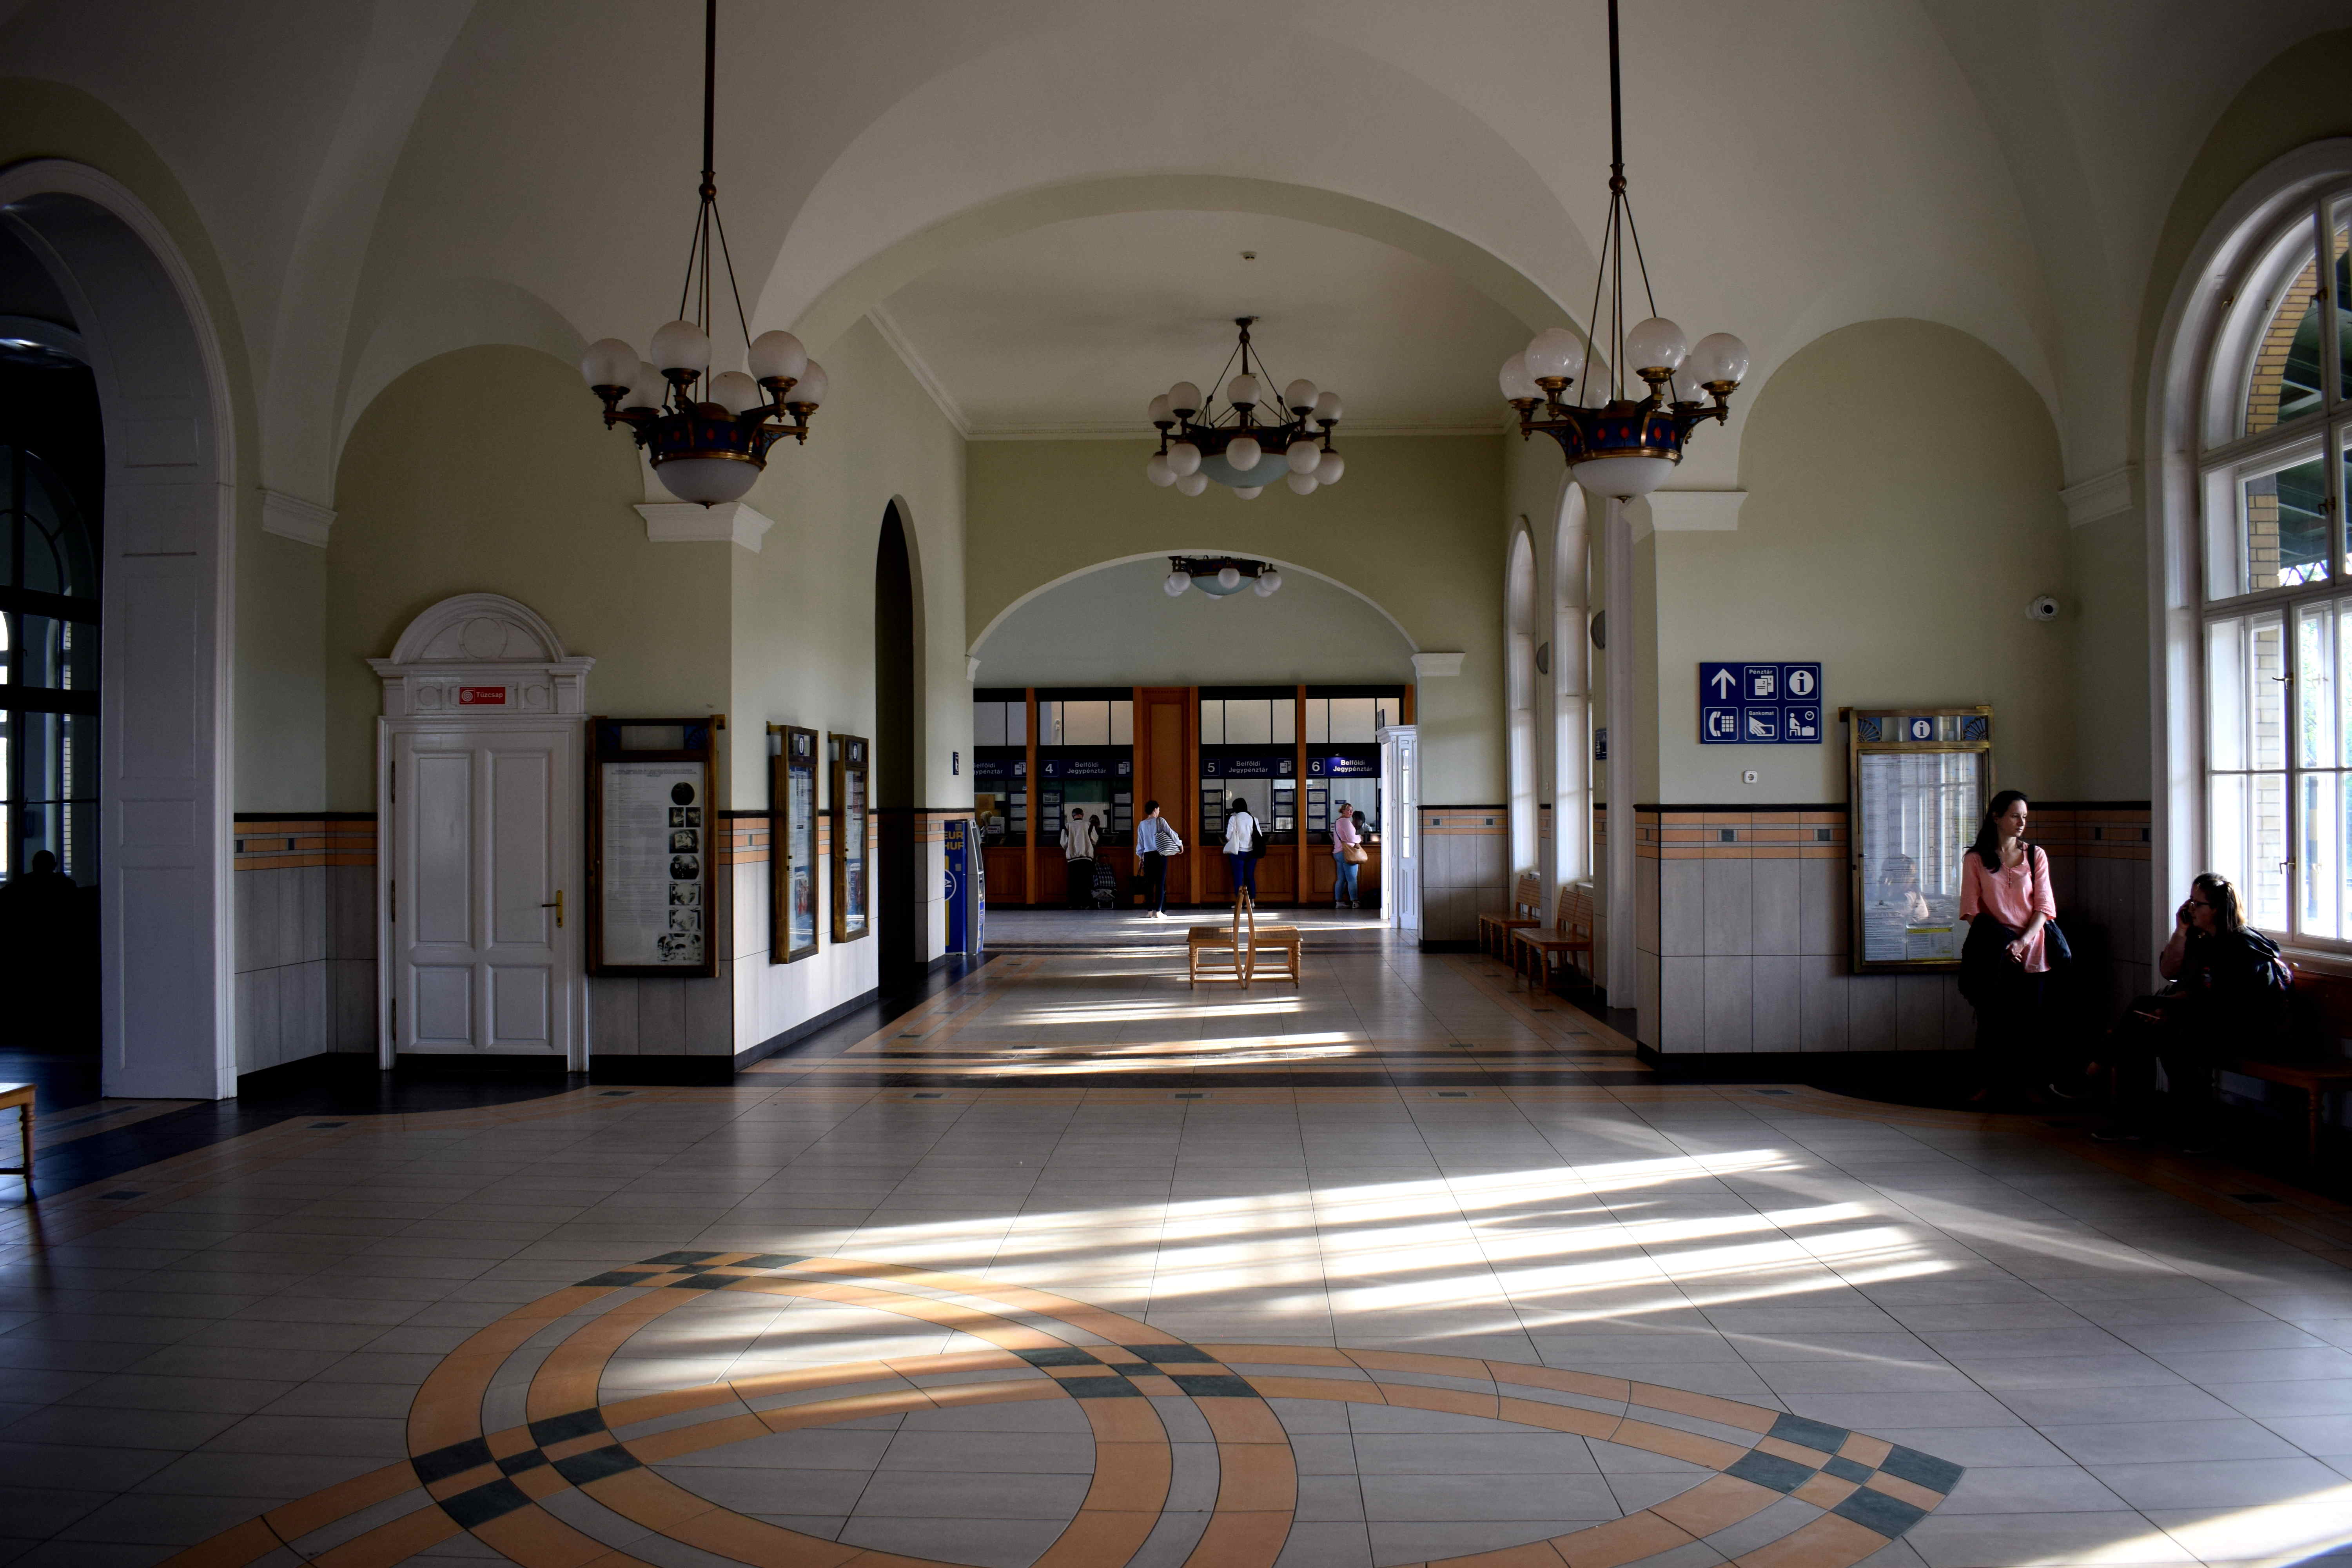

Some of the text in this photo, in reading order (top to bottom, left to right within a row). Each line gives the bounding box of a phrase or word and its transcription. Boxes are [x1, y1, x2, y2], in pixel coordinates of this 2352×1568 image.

[1045, 763, 1054, 773] 4
[1207, 762, 1215, 773] 5
[1312, 761, 1320, 771] 6
